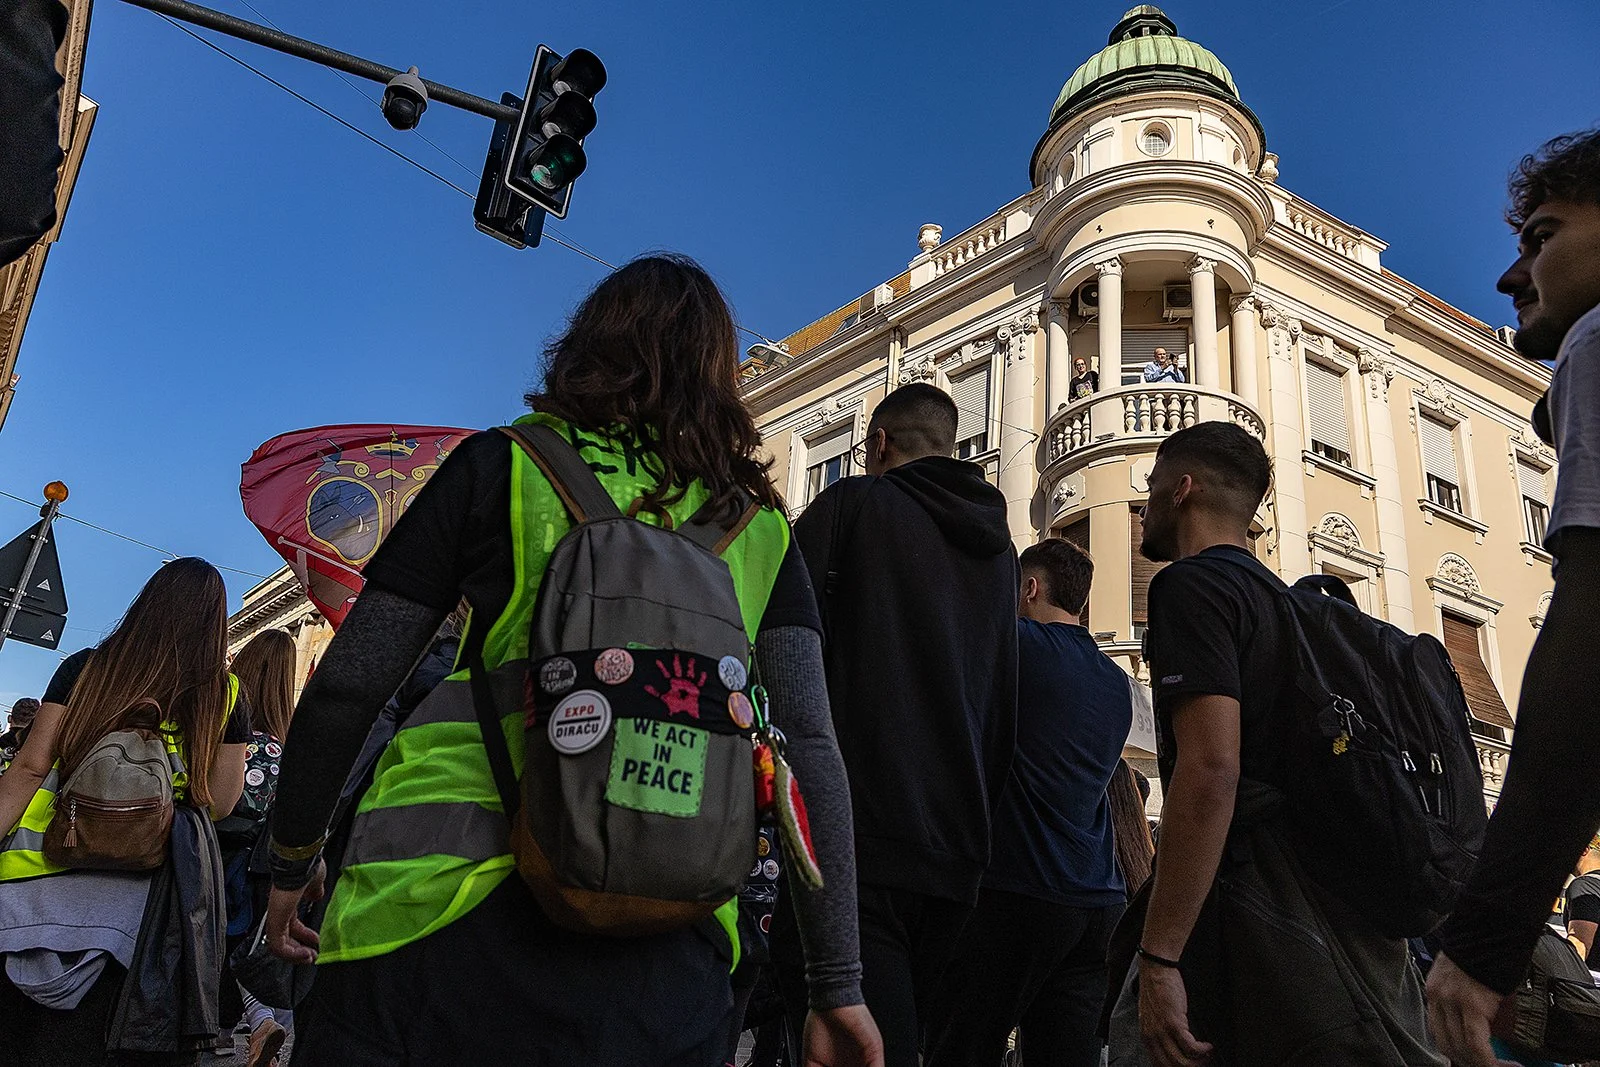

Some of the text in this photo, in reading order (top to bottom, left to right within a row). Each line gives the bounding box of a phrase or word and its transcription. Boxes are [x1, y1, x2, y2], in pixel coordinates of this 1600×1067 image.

[564, 704, 595, 718] EXPO
[633, 717, 697, 749] WE ACT
[653, 743, 672, 764] IN
[621, 758, 693, 795] PEACE
